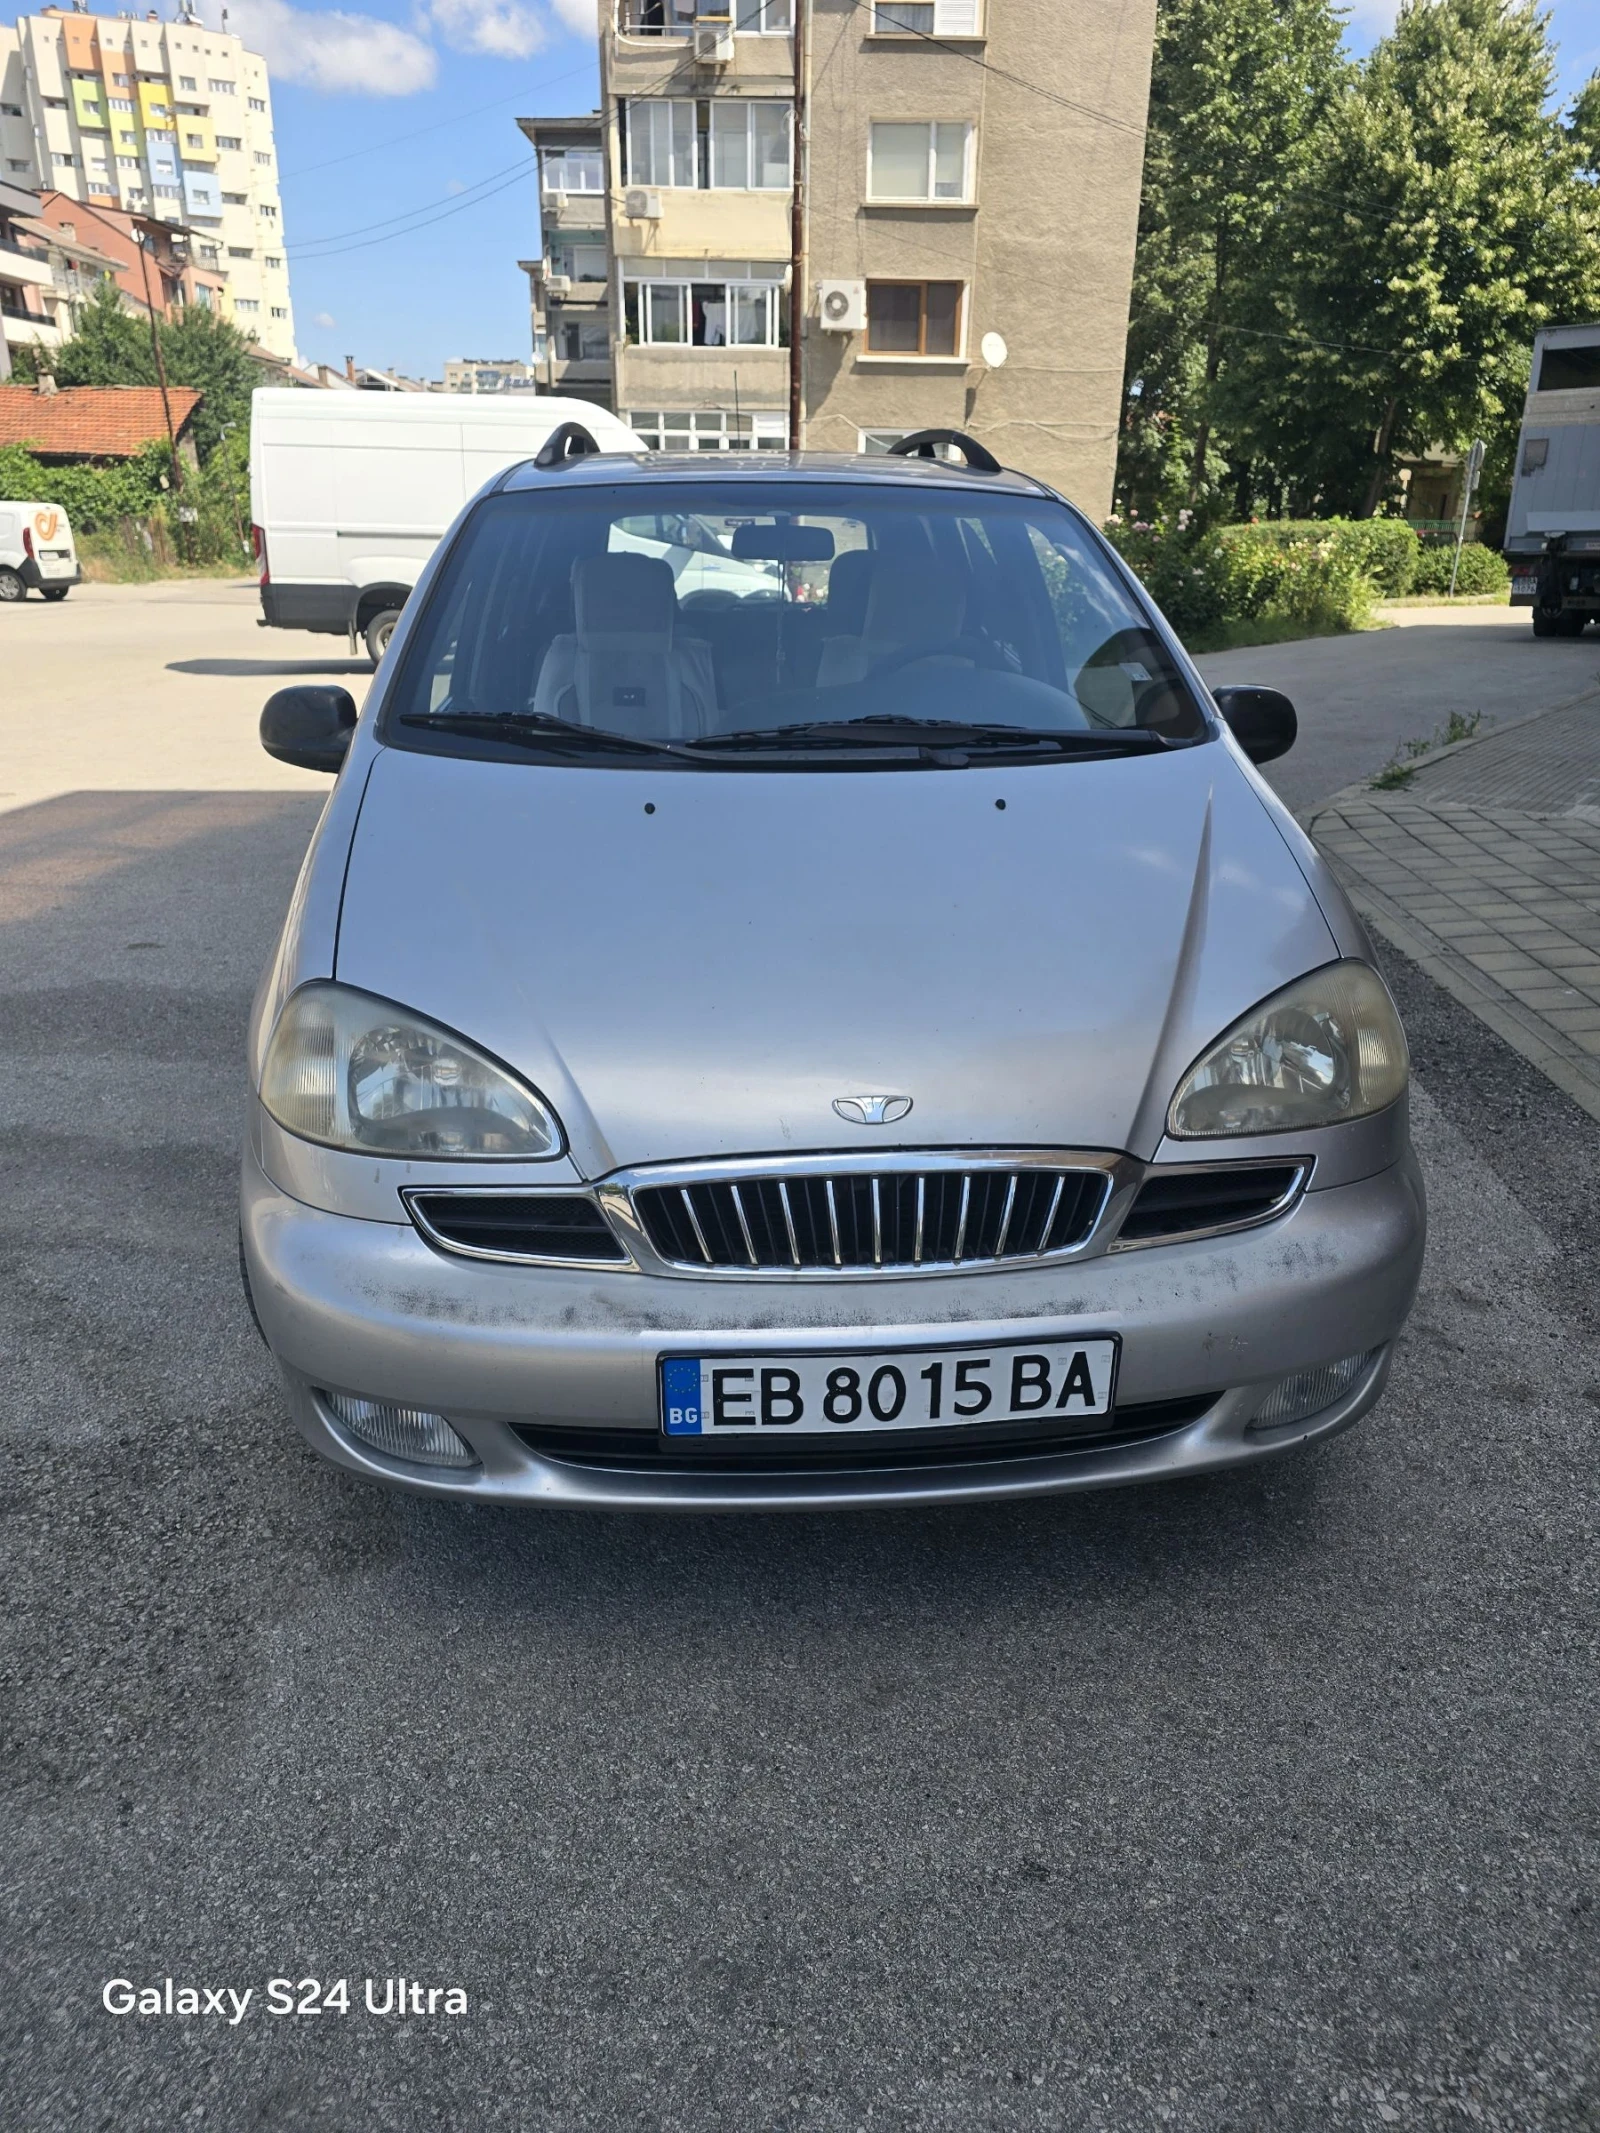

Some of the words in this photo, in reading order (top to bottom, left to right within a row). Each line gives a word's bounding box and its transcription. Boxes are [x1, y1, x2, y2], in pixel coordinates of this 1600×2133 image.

[712, 1367, 804, 1426] EB
[823, 1359, 992, 1424] 8015
[1009, 1351, 1096, 1412] BA
[669, 1407, 698, 1424] BG
